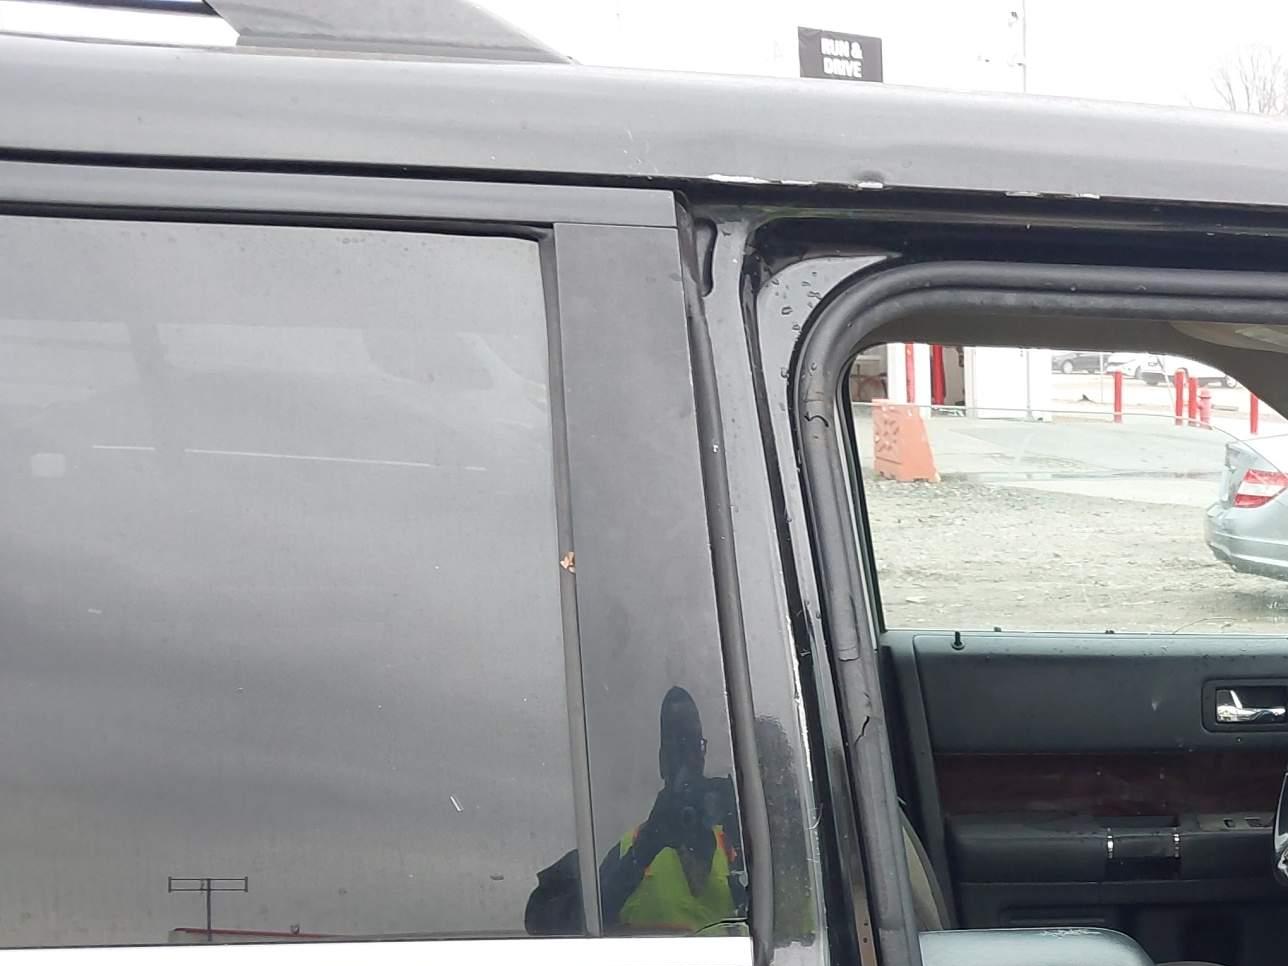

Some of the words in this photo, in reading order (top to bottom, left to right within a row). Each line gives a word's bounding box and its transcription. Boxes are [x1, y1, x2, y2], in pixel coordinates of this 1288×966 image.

[820, 37, 850, 58] RUN
[850, 41, 864, 59] &
[823, 56, 863, 78] DRIVE
